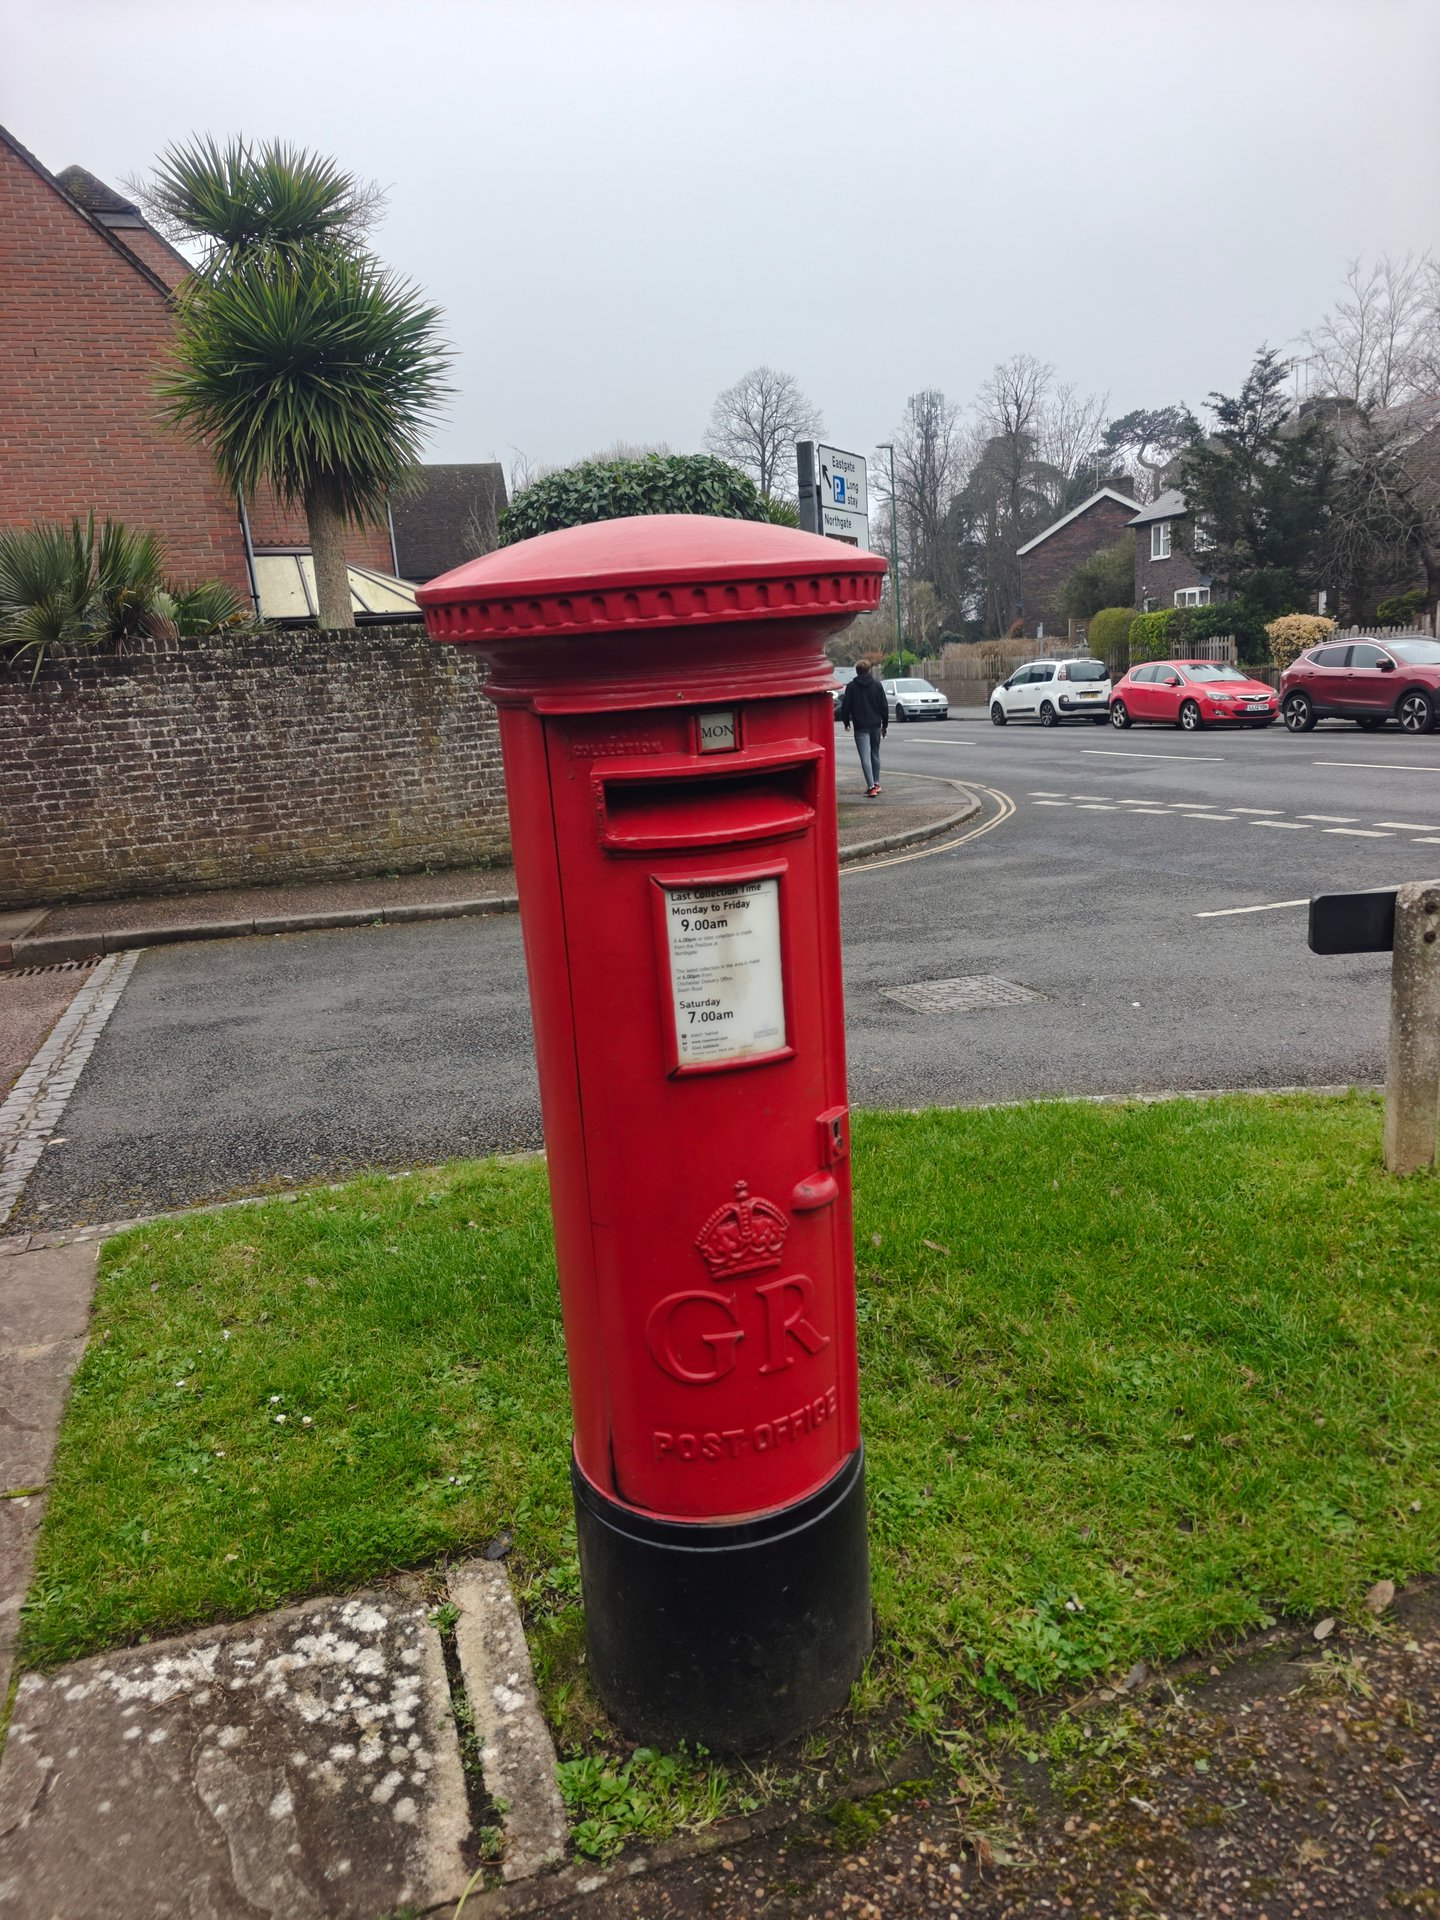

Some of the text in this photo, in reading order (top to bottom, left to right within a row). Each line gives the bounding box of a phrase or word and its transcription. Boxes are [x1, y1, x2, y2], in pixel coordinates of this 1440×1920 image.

[832, 456, 855, 473] Eastgate
[846, 480, 859, 493] Long
[847, 495, 858, 508] stay
[825, 513, 852, 529] Northgate
[701, 725, 734, 738] MON
[671, 883, 762, 901] Last Collection Time
[672, 900, 751, 916] Monday to Friday
[681, 919, 728, 932] 9.00am
[680, 998, 721, 1009] Saturday
[688, 1011, 734, 1024] 7.00am
[645, 1273, 831, 1385] GR
[653, 1385, 838, 1460] POST OFFICE
